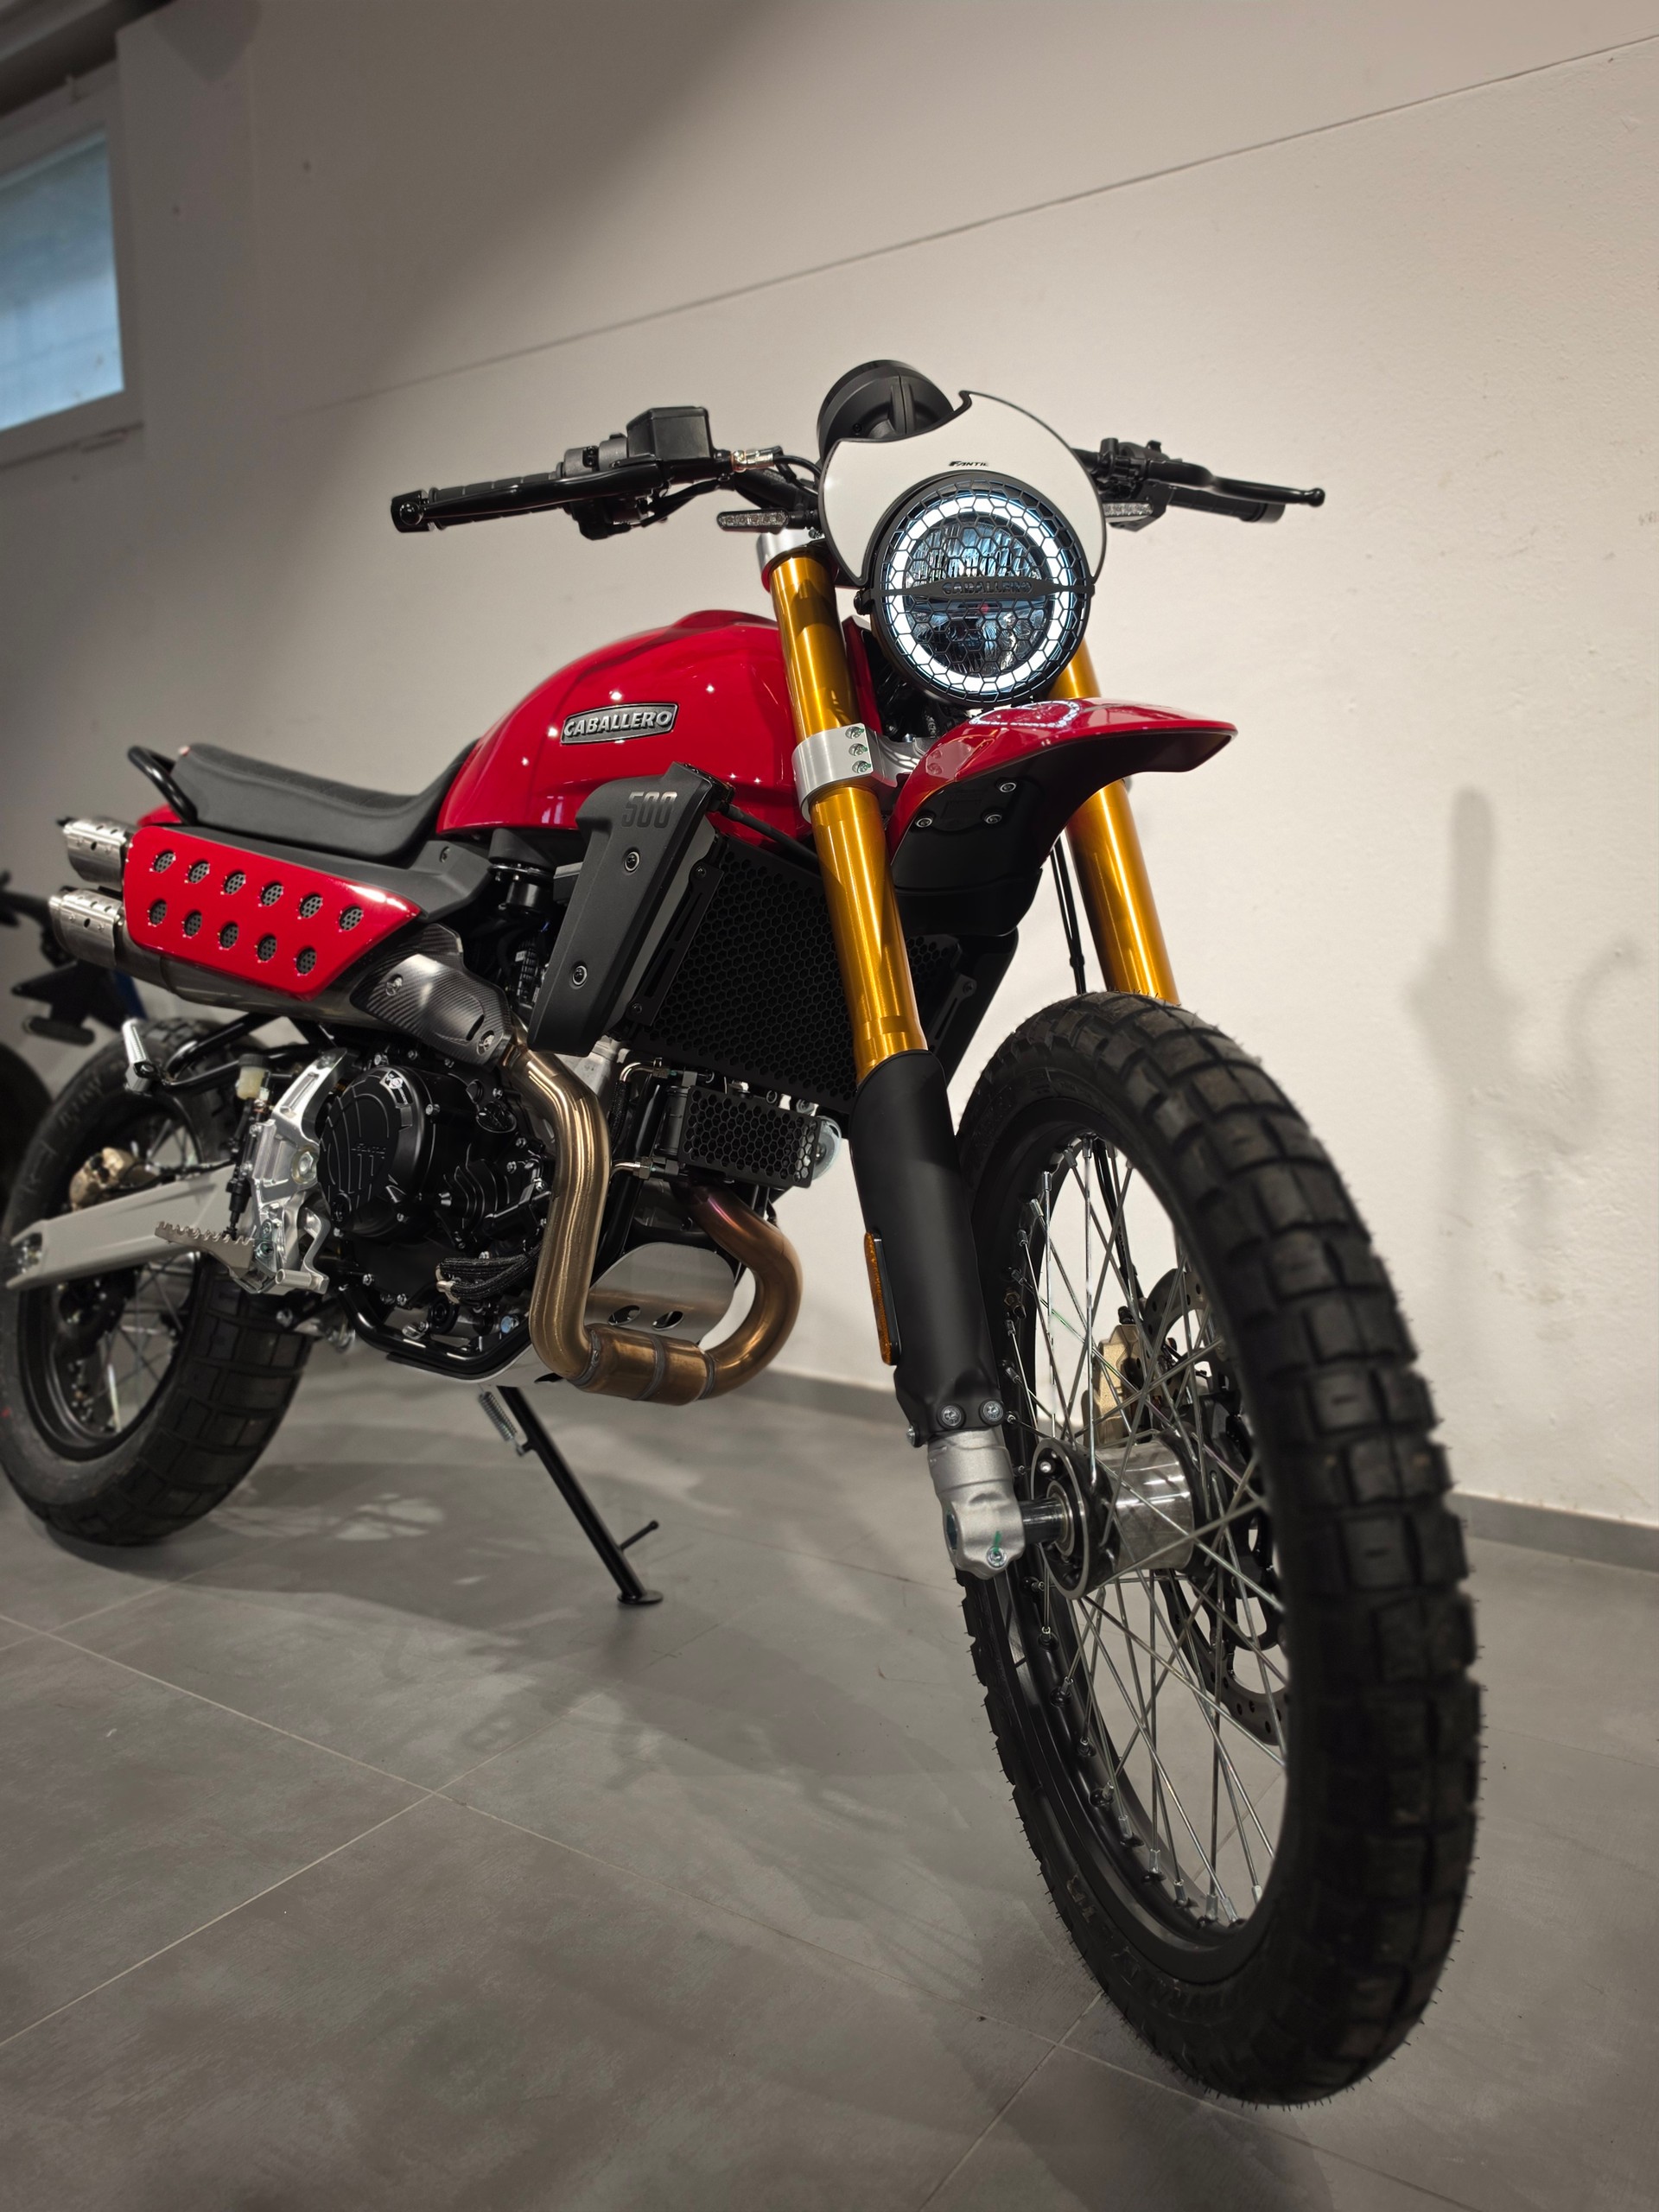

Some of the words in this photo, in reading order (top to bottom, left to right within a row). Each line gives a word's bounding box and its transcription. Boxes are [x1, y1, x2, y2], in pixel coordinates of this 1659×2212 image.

[942, 582, 1032, 594] CABALLERO
[563, 710, 673, 736] CABALLERO
[620, 791, 678, 829] 500
